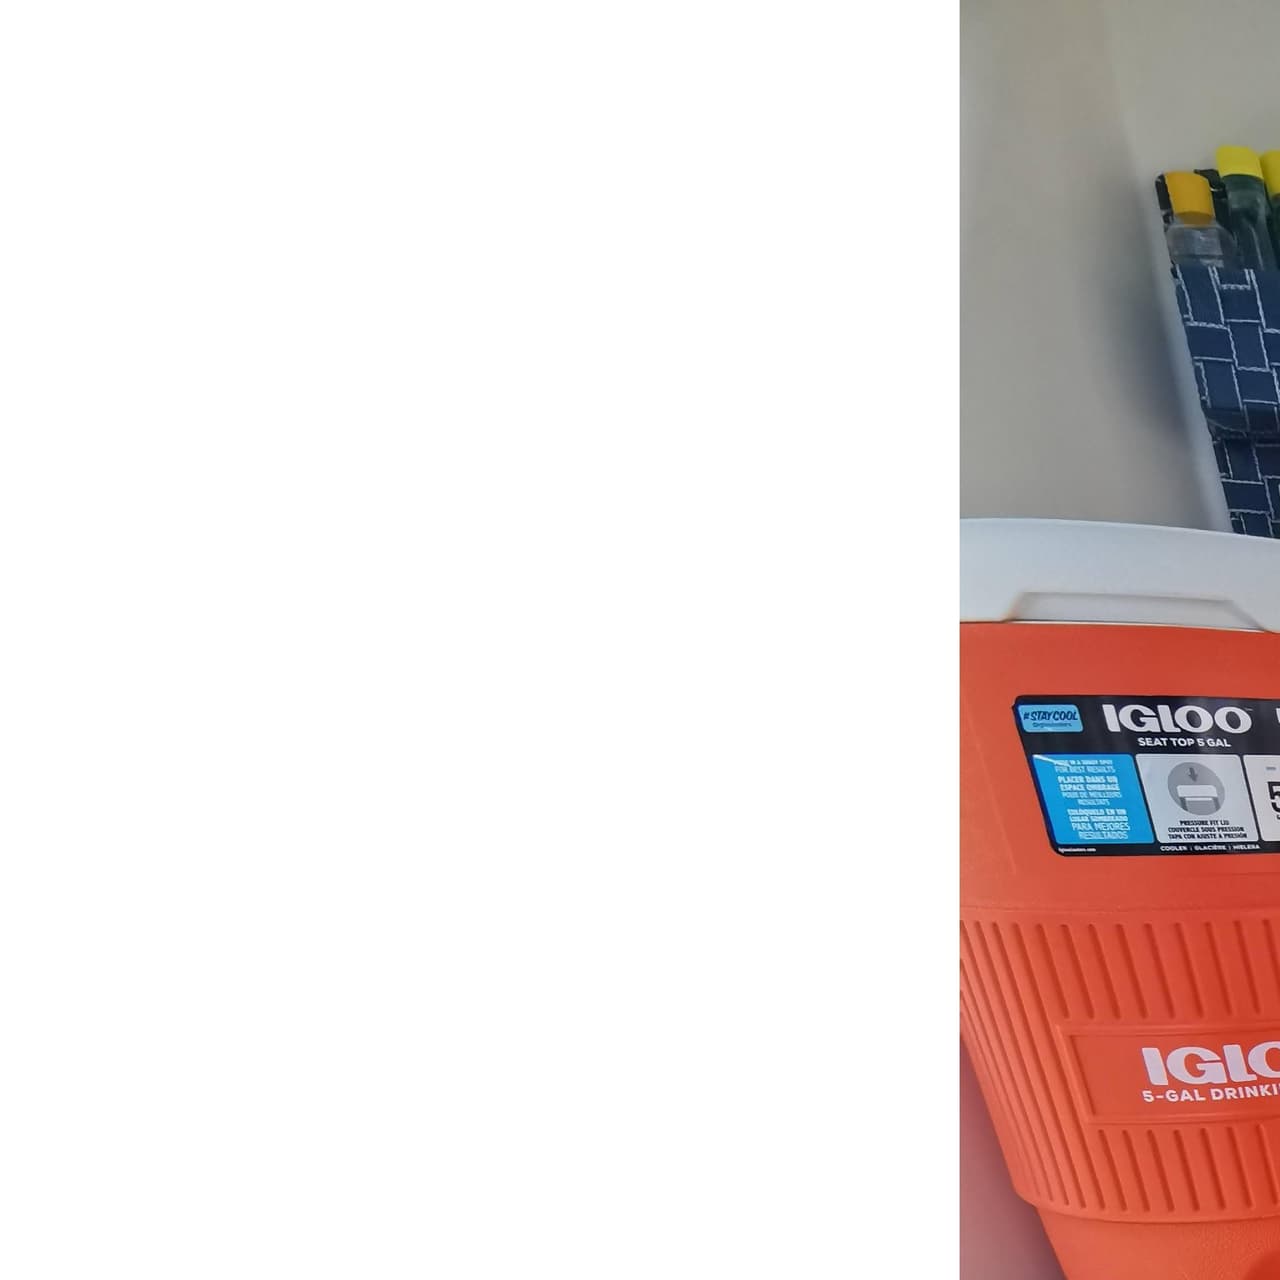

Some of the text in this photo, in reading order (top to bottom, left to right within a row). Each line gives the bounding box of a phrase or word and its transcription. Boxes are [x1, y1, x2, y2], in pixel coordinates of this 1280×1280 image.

[1102, 704, 1252, 734] IGLOO
[1138, 737, 1232, 748] SEAT TOP 5 GAL
[1142, 1087, 1206, 1103] 5-GAL
